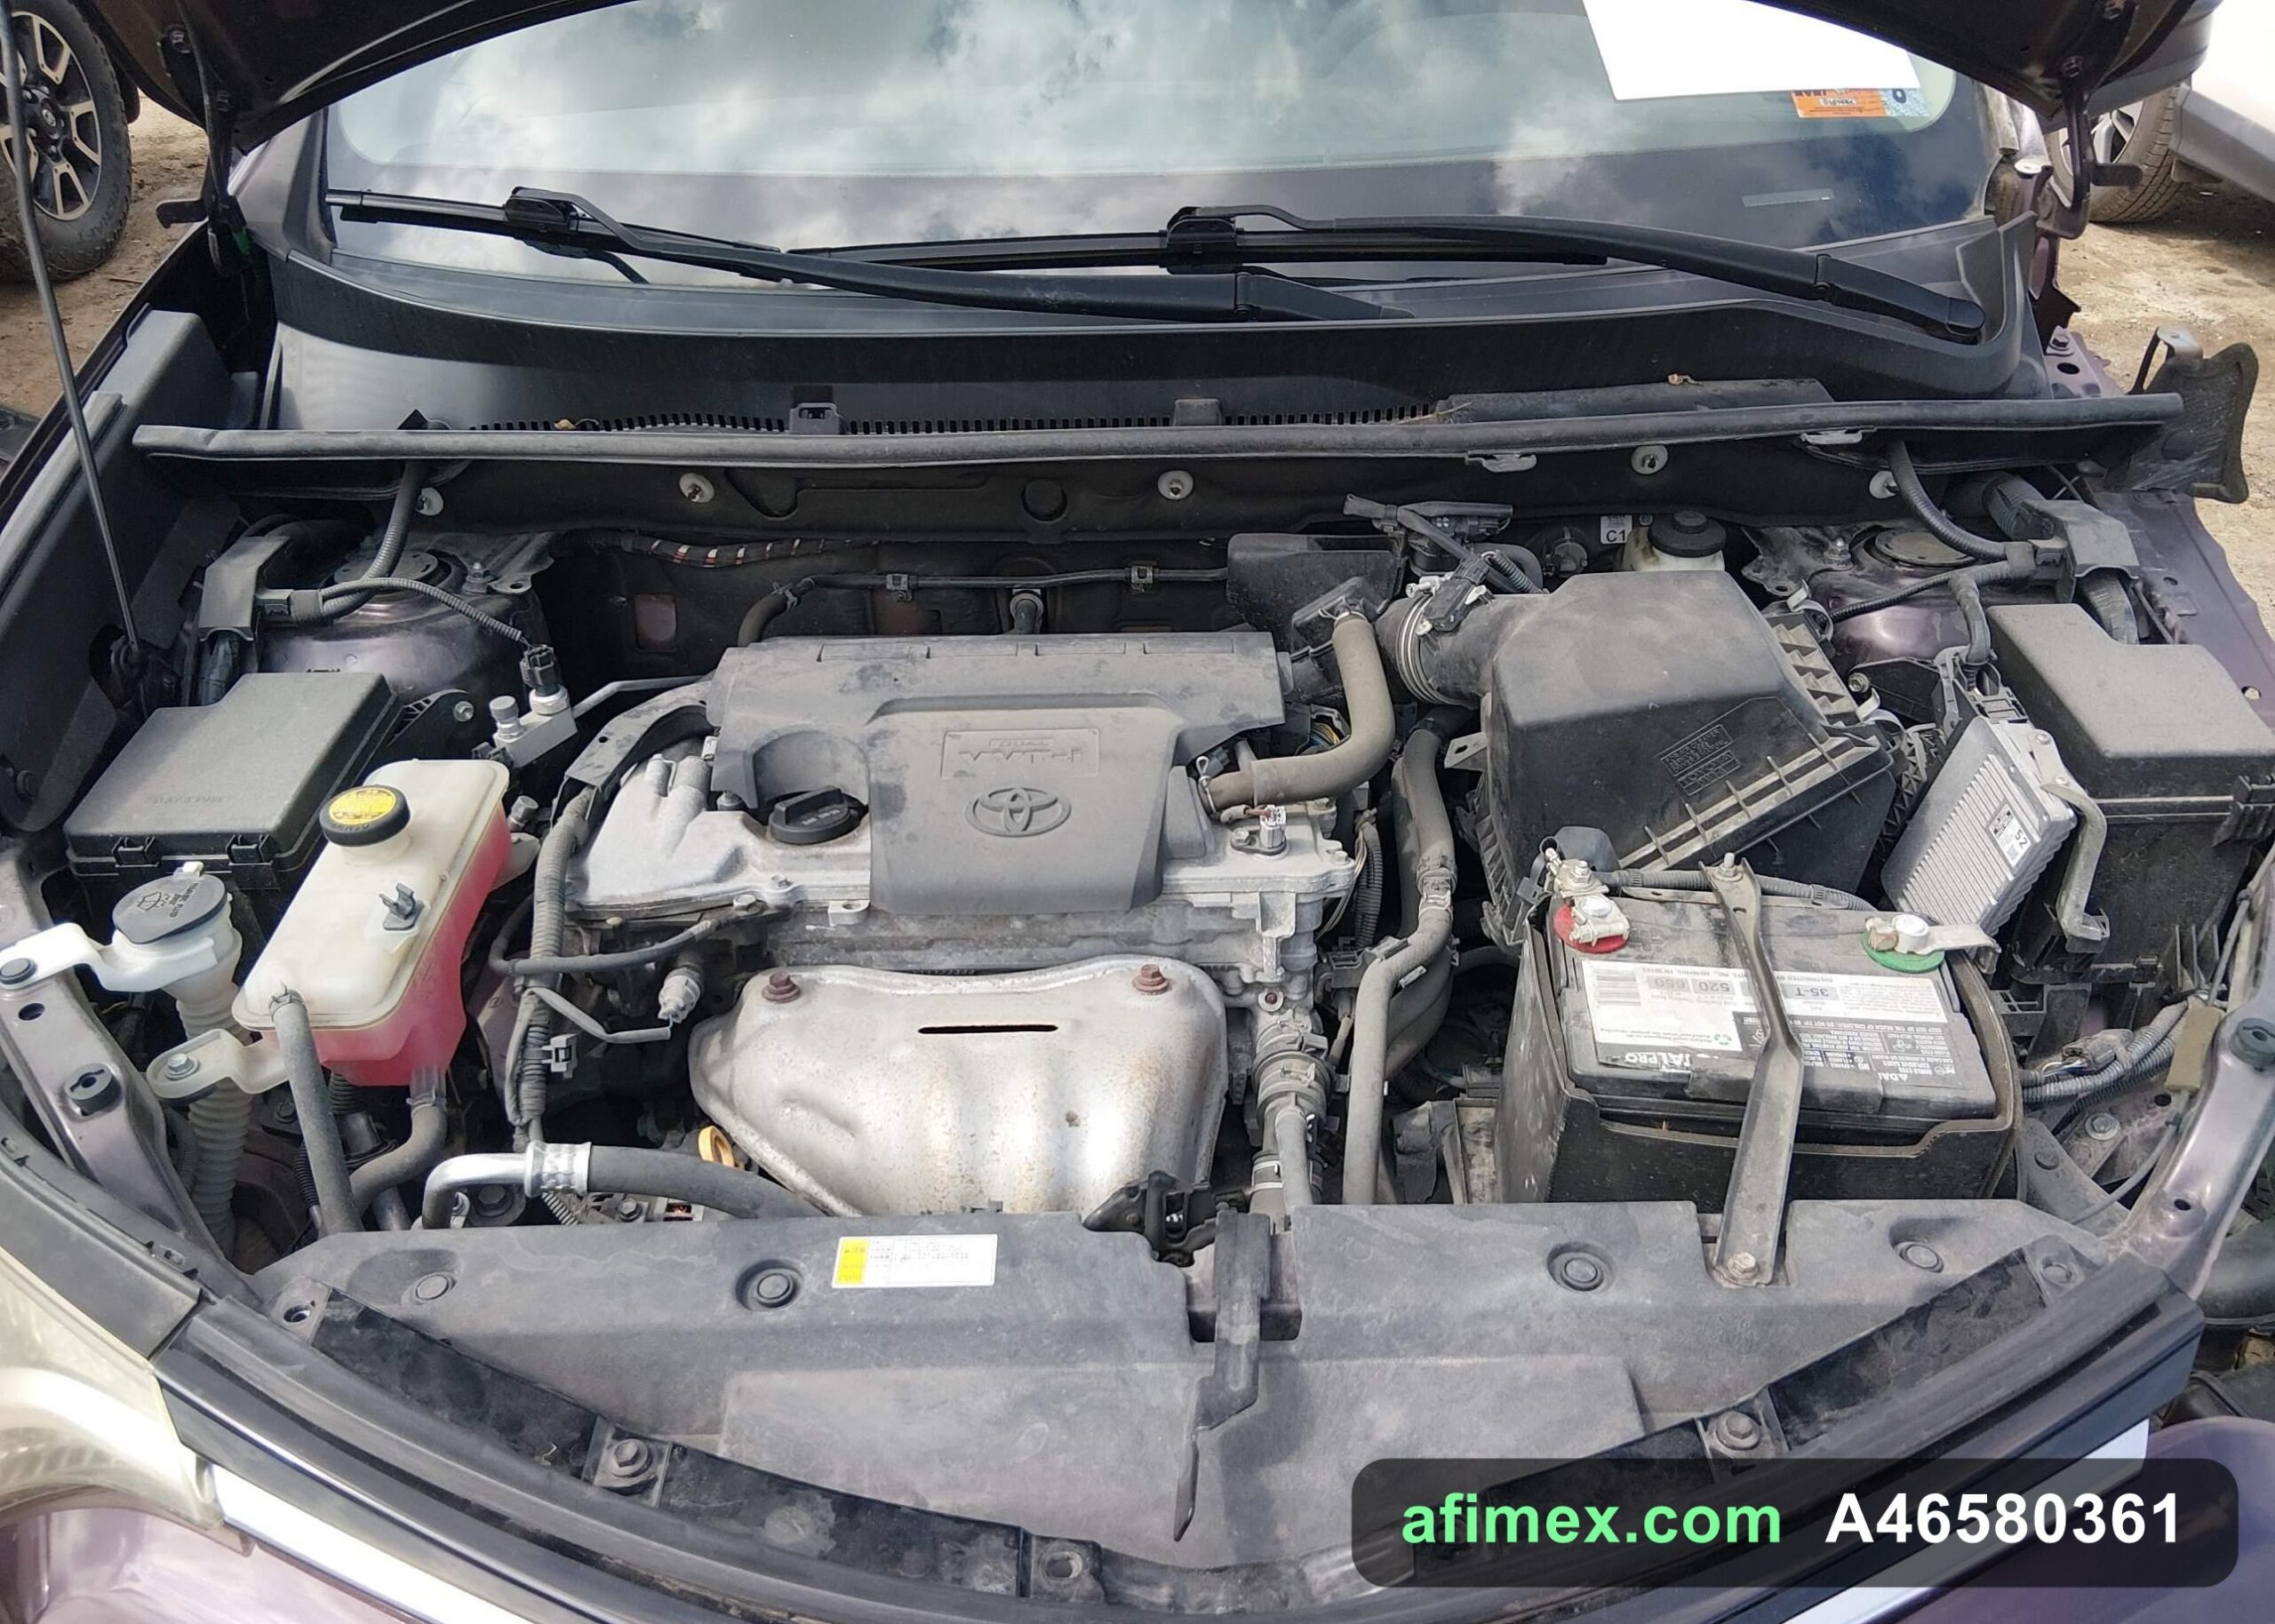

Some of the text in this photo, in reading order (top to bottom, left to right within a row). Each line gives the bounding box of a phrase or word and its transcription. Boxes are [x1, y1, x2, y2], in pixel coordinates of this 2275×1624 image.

[1606, 529, 1625, 543] C1
[2015, 830, 2029, 848] 52
[1654, 978, 1686, 989] 650
[1698, 981, 1730, 991] 520
[1794, 987, 1829, 997] 35-T
